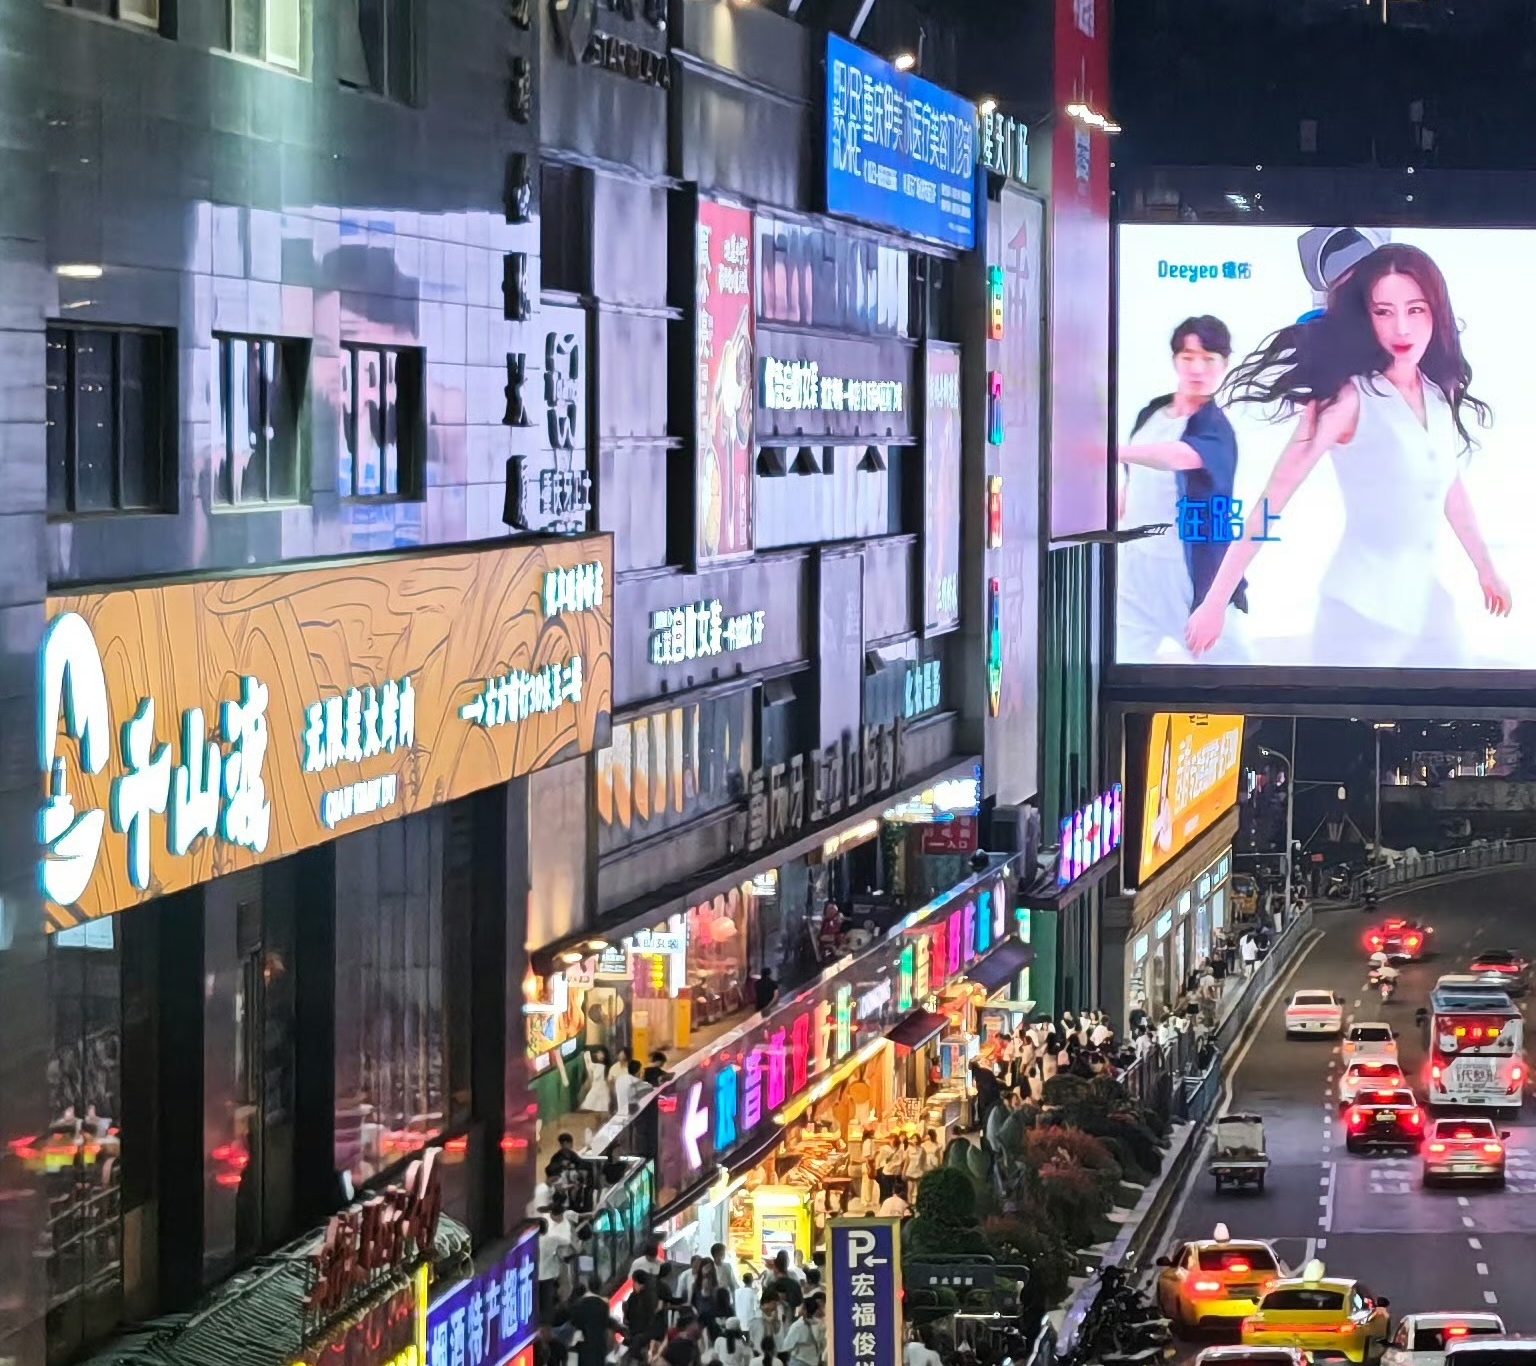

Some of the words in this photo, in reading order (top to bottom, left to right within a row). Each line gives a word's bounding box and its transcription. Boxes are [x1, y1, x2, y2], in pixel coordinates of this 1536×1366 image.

[1157, 260, 1219, 282] Deeyeo
[1175, 495, 1282, 543] 在路上
[849, 1230, 876, 1268] P
